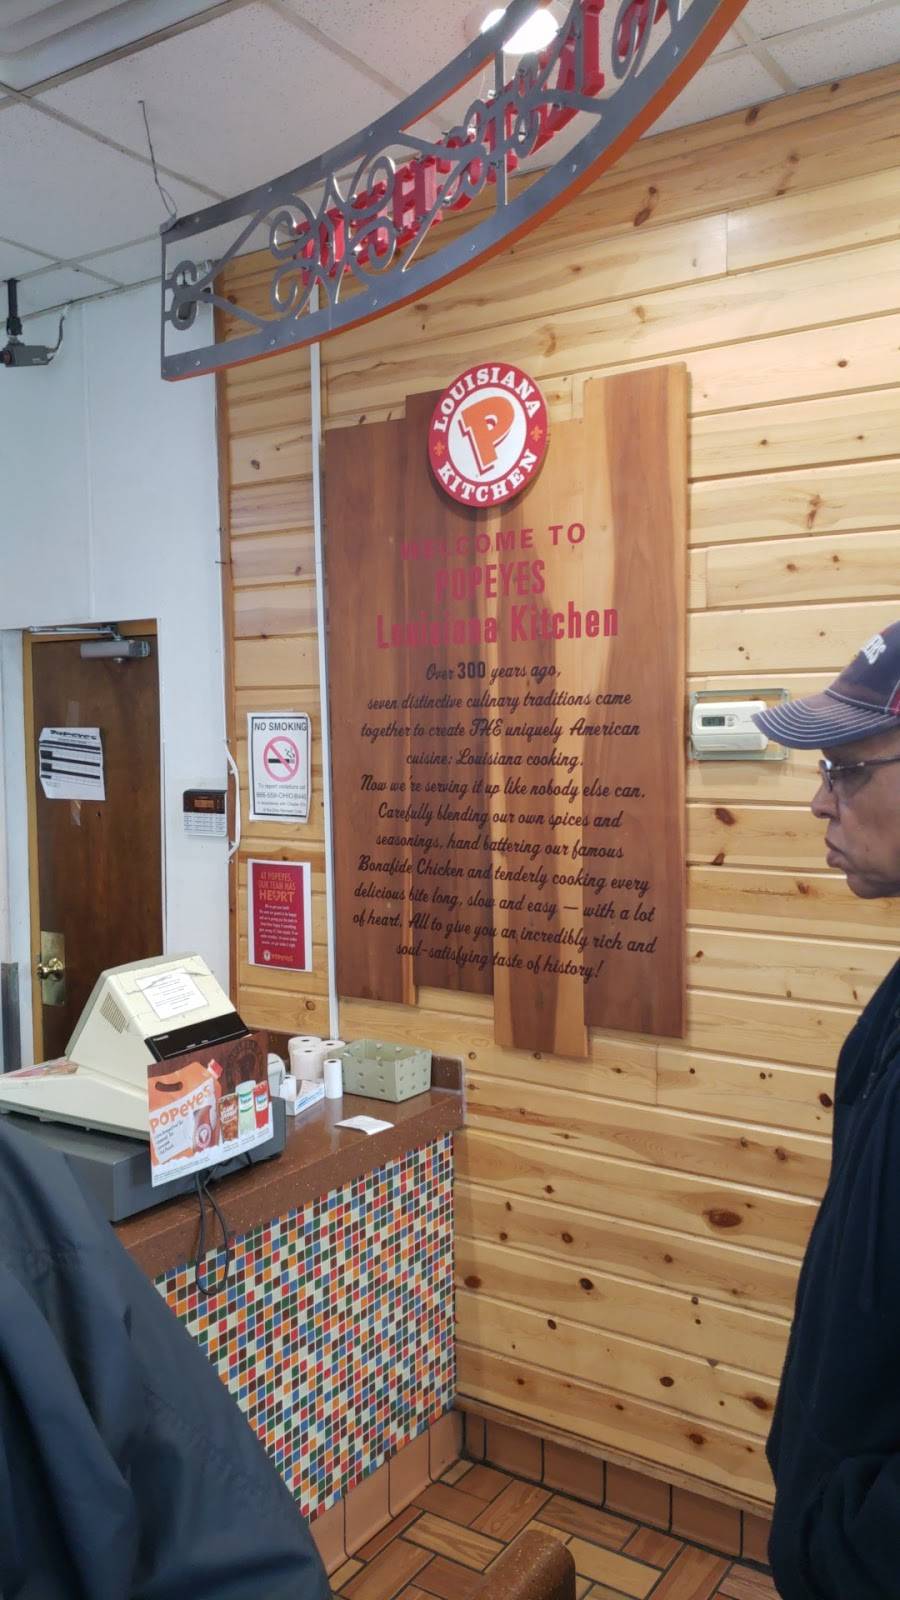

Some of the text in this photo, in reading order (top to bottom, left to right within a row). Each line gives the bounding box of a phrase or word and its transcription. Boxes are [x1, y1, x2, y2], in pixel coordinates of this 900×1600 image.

[433, 367, 541, 432] LOUISIANA
[438, 448, 538, 502] KITCHEN
[548, 523, 585, 546] TO
[435, 559, 545, 605] POPEYES
[511, 600, 619, 642] Kitchen
[426, 661, 561, 685] Over 300 years ago,
[367, 689, 633, 714] seven distinctive culinary traditions came
[254, 721, 308, 732] NO SMOKING
[361, 717, 641, 744] together to create THE uniquely American
[406, 747, 583, 774] cuisine: Louisiana cooking.
[361, 774, 646, 803] Now we're serving it up like nobody else can.
[378, 801, 624, 830] Carefully blending our own spices and
[446, 832, 481, 850] hand
[483, 834, 541, 861] battering
[544, 844, 569, 856] our
[571, 839, 624, 860] famous
[357, 854, 650, 899] Bonafide Chicken and tenderly cooking every
[354, 881, 406, 900] delicious
[408, 886, 430, 903] bite
[467, 890, 496, 909] slow
[498, 894, 526, 911] and
[527, 901, 558, 921] easy
[582, 900, 616, 919] with
[619, 908, 630, 921] a
[633, 902, 656, 922] lot
[352, 909, 366, 928] of
[408, 911, 431, 930] All
[430, 918, 443, 931] to
[446, 920, 472, 940] give
[473, 925, 498, 942] you
[500, 927, 517, 940] an
[520, 926, 589, 954] incredibly
[593, 931, 623, 951] rich
[626, 936, 658, 954] and
[396, 940, 605, 985] soul-satisfying taste of history!
